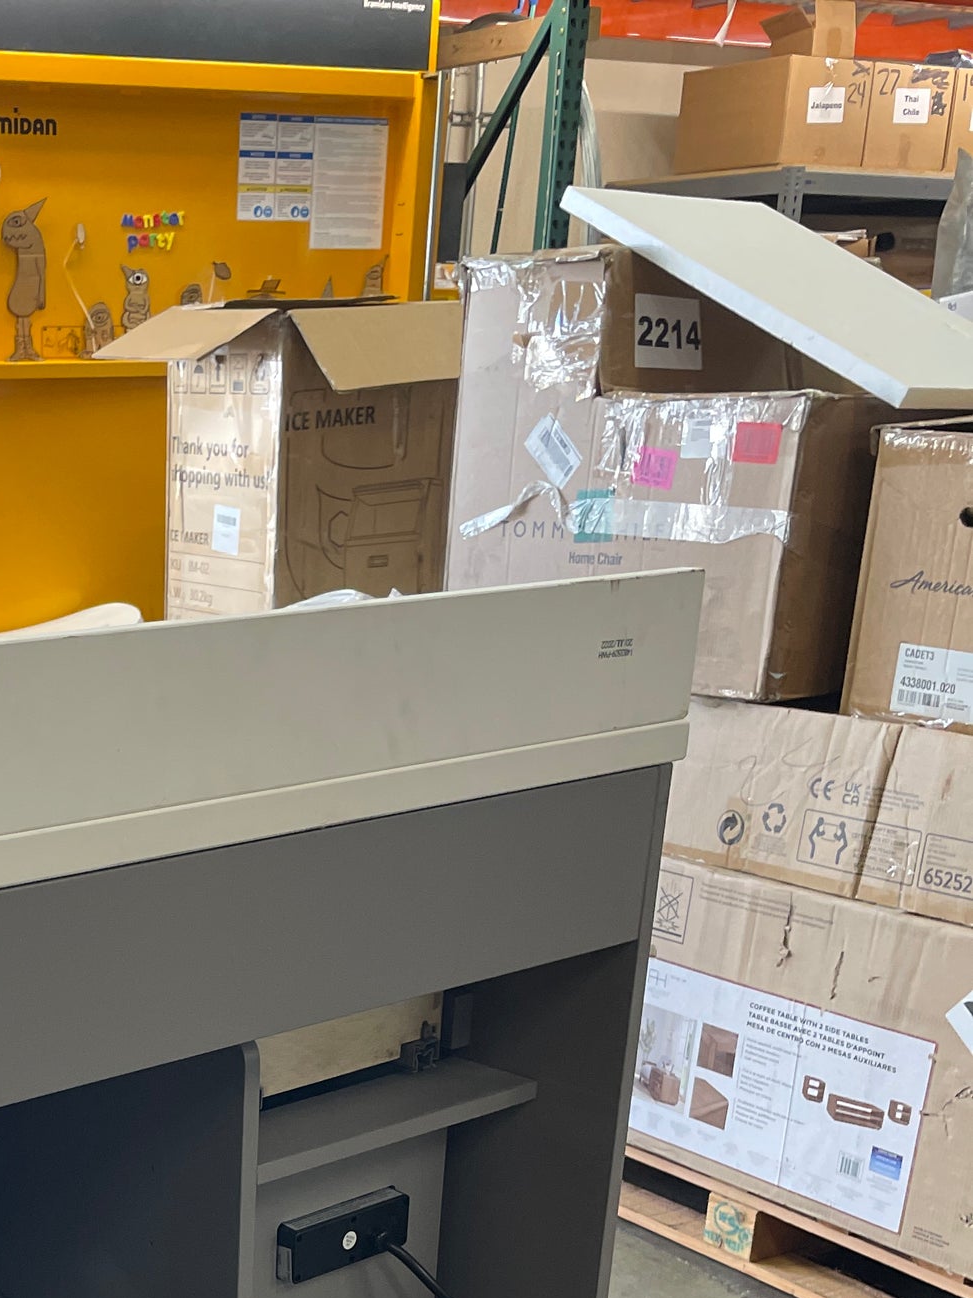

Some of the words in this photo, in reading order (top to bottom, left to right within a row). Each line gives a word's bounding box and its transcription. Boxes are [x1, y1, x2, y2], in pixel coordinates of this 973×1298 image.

[847, 80, 866, 109] 24
[877, 68, 901, 96] 27
[810, 101, 843, 111] Jalapeno
[902, 108, 920, 116] Chile
[904, 95, 919, 103] Thai
[637, 316, 700, 350] 2214
[285, 411, 310, 432] ICE
[315, 405, 376, 430] MAKER
[172, 436, 203, 456] Thank
[206, 442, 228, 462] you
[231, 438, 249, 459] for
[224, 468, 250, 488] with
[568, 551, 596, 565] Home
[597, 552, 623, 566] Chair
[889, 570, 973, 597] America
[899, 675, 956, 695] 4338001.020
[841, 793, 861, 807] CA
[844, 781, 863, 794] UK
[748, 1011, 769, 1023] TABLE
[769, 1018, 792, 1030] BASSE
[793, 1026, 812, 1037] AVEC
[819, 1033, 845, 1047] TABLES
[846, 1042, 886, 1060] D'APPOINT
[749, 1002, 776, 1015] COFFEE
[777, 1009, 799, 1022] TABLE
[799, 1016, 818, 1028] WITH
[824, 1025, 841, 1036] SIDE
[842, 1030, 869, 1045] TABLES
[746, 1020, 765, 1031] MESA
[766, 1026, 776, 1035] DE
[776, 1030, 804, 1044] CENTRO
[805, 1039, 821, 1049] CON
[827, 1046, 852, 1060] MESAS
[853, 1055, 897, 1074] AUXILIARES
